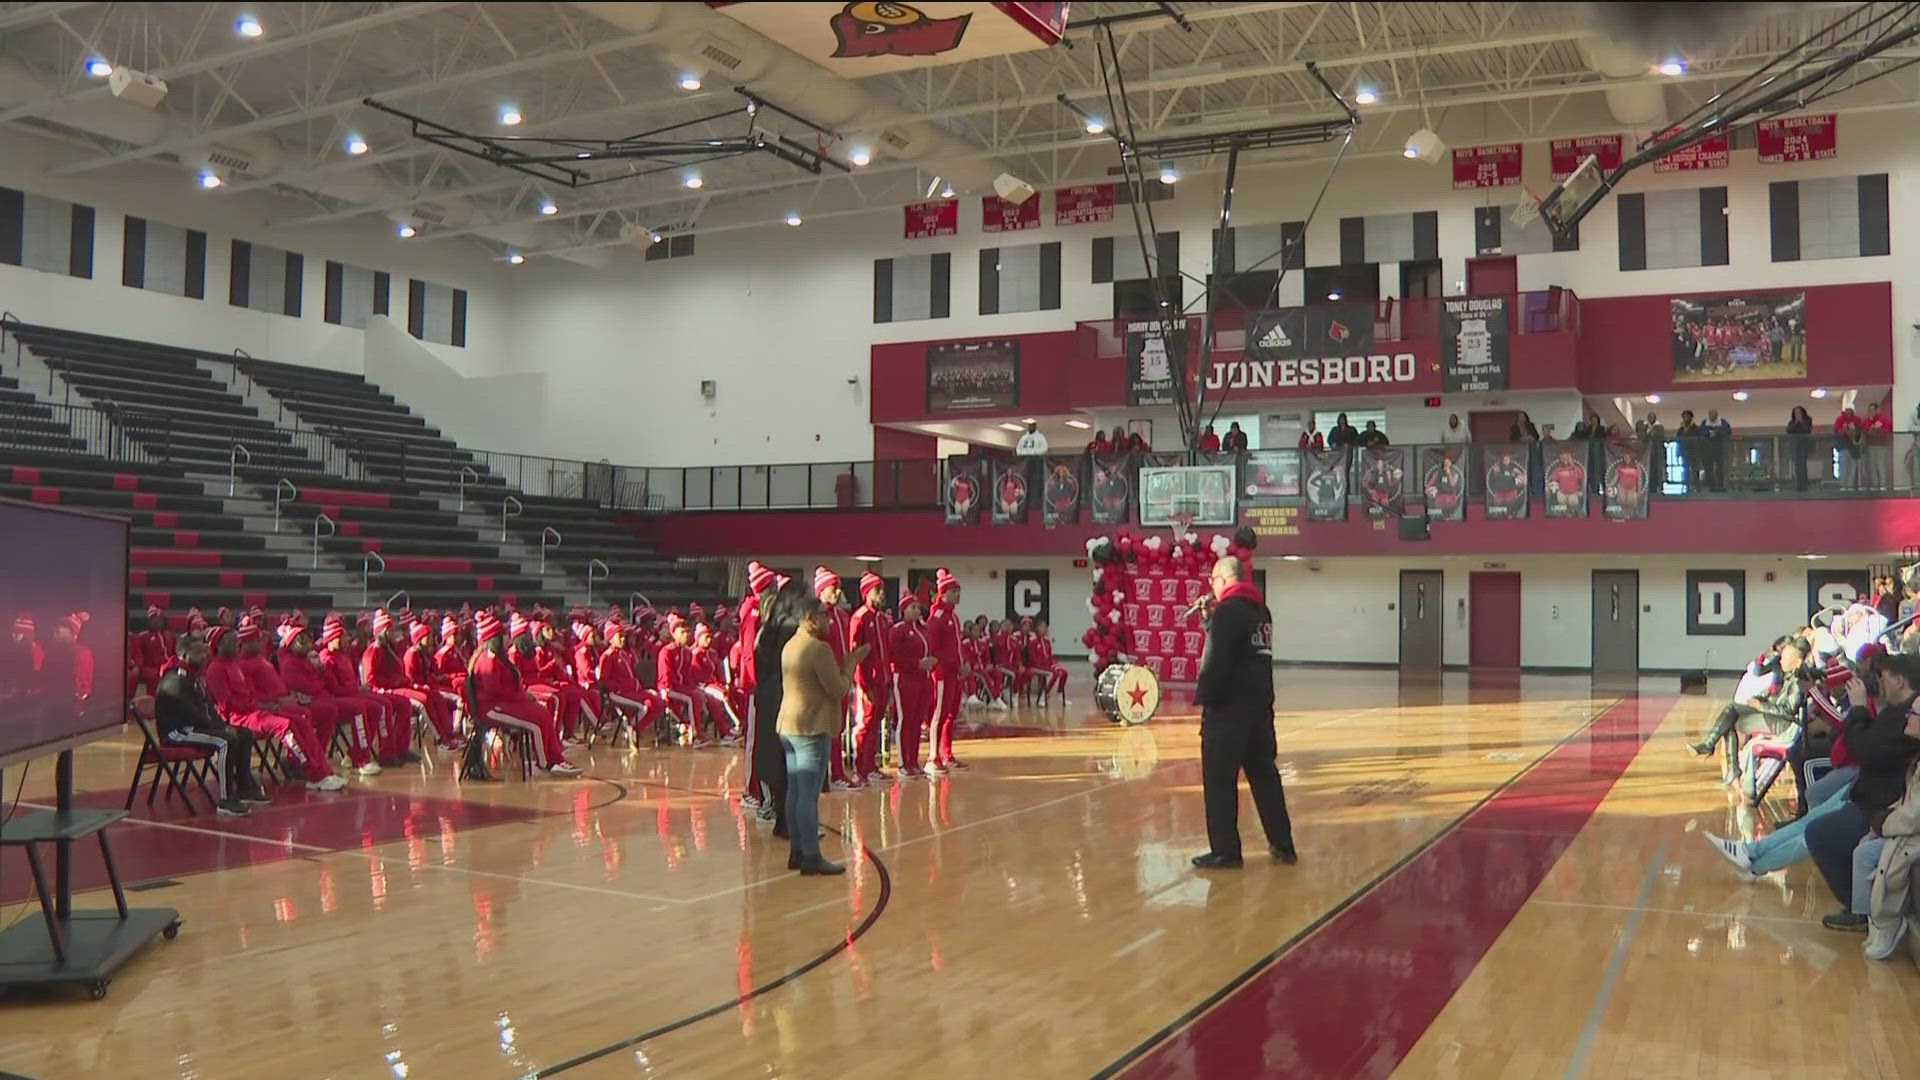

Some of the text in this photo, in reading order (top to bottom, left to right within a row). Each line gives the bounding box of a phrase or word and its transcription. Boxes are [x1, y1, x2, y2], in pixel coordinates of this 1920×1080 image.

[1760, 116, 1830, 131] BOYS BASKETBALL
[1553, 136, 1619, 149] BOYS BASKETBALL
[1784, 135, 1808, 144] 2024
[1456, 145, 1519, 157] BOYS BASKETBALL
[1698, 151, 1727, 160] CHAMPS
[1759, 154, 1784, 163] RANKED
[1815, 148, 1835, 158] STATE
[1709, 158, 1727, 167] STATE
[1503, 176, 1520, 185] STATE
[1446, 299, 1502, 313] TONEY DOUGLAS
[1179, 319, 1186, 329] IV
[1259, 339, 1291, 347] adidas
[1206, 354, 1415, 390] JONESBORO
[1458, 366, 1473, 374] Round
[1489, 365, 1500, 373] Pick
[1014, 580, 1041, 617] C
[1698, 582, 1735, 625] D
